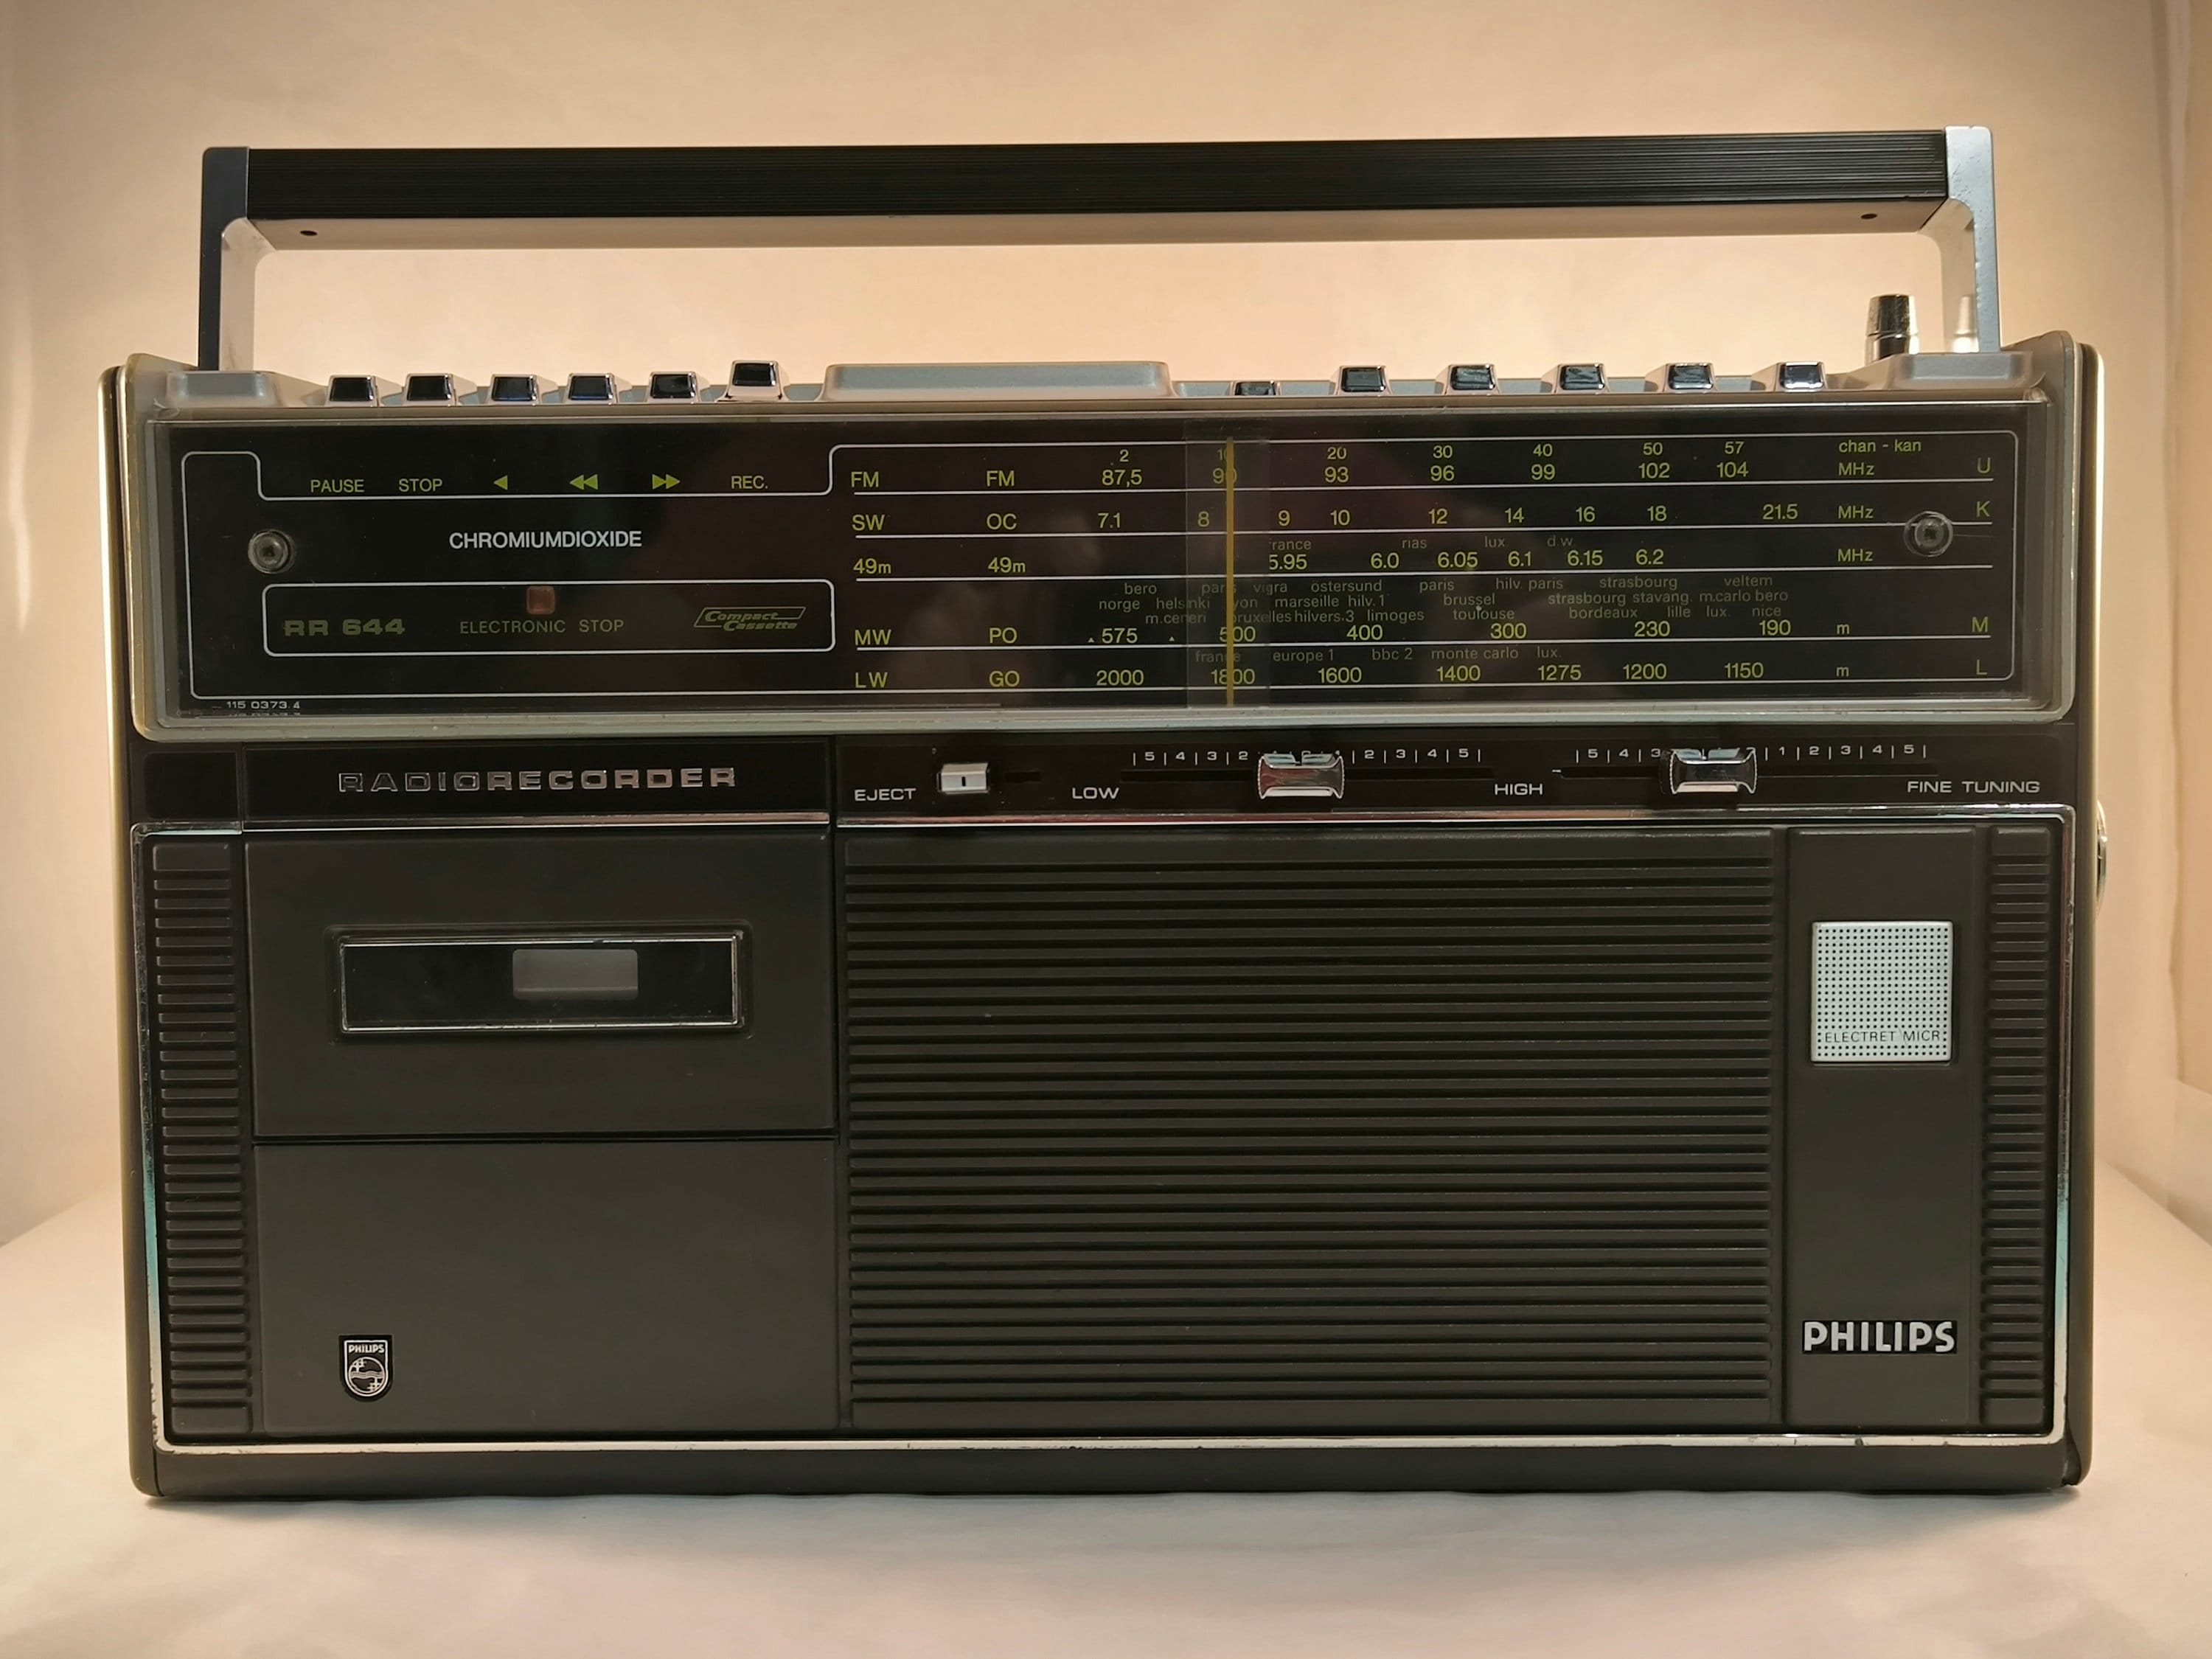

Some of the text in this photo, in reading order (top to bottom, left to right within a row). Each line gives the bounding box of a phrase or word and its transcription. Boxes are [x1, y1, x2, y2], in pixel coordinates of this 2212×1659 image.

[1119, 449, 1129, 462] 2
[1327, 447, 1347, 460] 20
[1433, 445, 1453, 459] 30
[1533, 443, 1553, 457] 40
[1643, 442, 1663, 456] 50
[1724, 442, 1745, 455] 57
[1838, 439, 1876, 453] chan
[1894, 439, 1921, 452] kan
[851, 471, 880, 488] FM
[986, 470, 1015, 487] FM
[1102, 469, 1143, 488] 87,5
[1324, 466, 1349, 483] 93
[1430, 465, 1455, 481] 96
[1531, 464, 1556, 480] 99
[1638, 462, 1670, 479] 102
[1716, 461, 1748, 478] 104
[1838, 462, 1875, 476] MHz
[1977, 457, 1991, 473] U
[310, 478, 443, 494] PAUSE STOP
[731, 475, 768, 490] REC.
[852, 501, 1990, 531] SW OC 7.1 8 9 10 12 14 16 18 21.5 MHz K
[449, 530, 642, 550] CHROMIUMDIOXIDE
[1269, 539, 1312, 551] rance
[1402, 538, 1427, 549] rias
[853, 549, 1874, 574] 49m 49m 5.95 6.0 6.05 6.1 6.15 6.2 MHz
[1124, 582, 1157, 595] bero
[1202, 583, 1237, 597] pars
[1419, 578, 1455, 593] paris
[1528, 578, 1564, 592] paris
[1599, 576, 1677, 590] strasbourg
[1724, 574, 1773, 587] veltem
[1099, 598, 1141, 612] norge
[1233, 597, 1258, 611] yon
[1275, 595, 1340, 608] marseille
[1444, 593, 1495, 606] brussel
[1548, 592, 1626, 606] strasbourg
[1755, 590, 1788, 601] bero
[705, 611, 779, 622] Compact
[1367, 609, 1425, 624] limoges
[1453, 608, 1514, 620] toulouse
[1569, 606, 1638, 619] bordeaux
[1667, 605, 1691, 618] lille
[1752, 605, 1781, 617] nice
[285, 619, 406, 636] RR 644
[460, 619, 624, 634] ELECTRONIC STOP
[723, 620, 797, 631] Cassette
[855, 616, 1988, 646] MW PO 575 500 400 300 230 190 m M
[1195, 650, 1241, 663] frane
[1273, 650, 1324, 664] europe
[1329, 649, 1334, 661] 1
[1372, 648, 1399, 661] bbc
[1404, 647, 1413, 660] 2
[1431, 648, 1478, 659] monte
[1484, 647, 1519, 659] carlo
[989, 670, 1020, 687] GO
[1096, 669, 1144, 686] 2000
[1211, 668, 1256, 684] 1800
[1318, 667, 1363, 684] 1600
[1436, 665, 1481, 681] 1400
[1537, 664, 1582, 681] 1275
[1622, 664, 1667, 680] 1200
[1724, 662, 1764, 678] 1150
[1836, 666, 1849, 677] m
[1976, 659, 1987, 675] L
[226, 700, 246, 709] 115
[1144, 751, 1249, 761] 5 4 3 2
[1364, 748, 1470, 759] 2 3 4 5
[1587, 748, 1661, 759] 5 4 3
[1778, 745, 1915, 755] 1 2 3 4 5
[338, 767, 736, 793] RADIORECORDER
[1907, 781, 2040, 793] FINE TUNING
[855, 788, 917, 801] EJECT
[1071, 787, 1120, 800] LOW
[1495, 783, 1543, 796] HIGH
[1824, 1030, 1940, 1043] ELECTRET MICR
[1804, 1321, 1955, 1352] PHILIPS
[348, 1344, 385, 1354] PHILIPS
